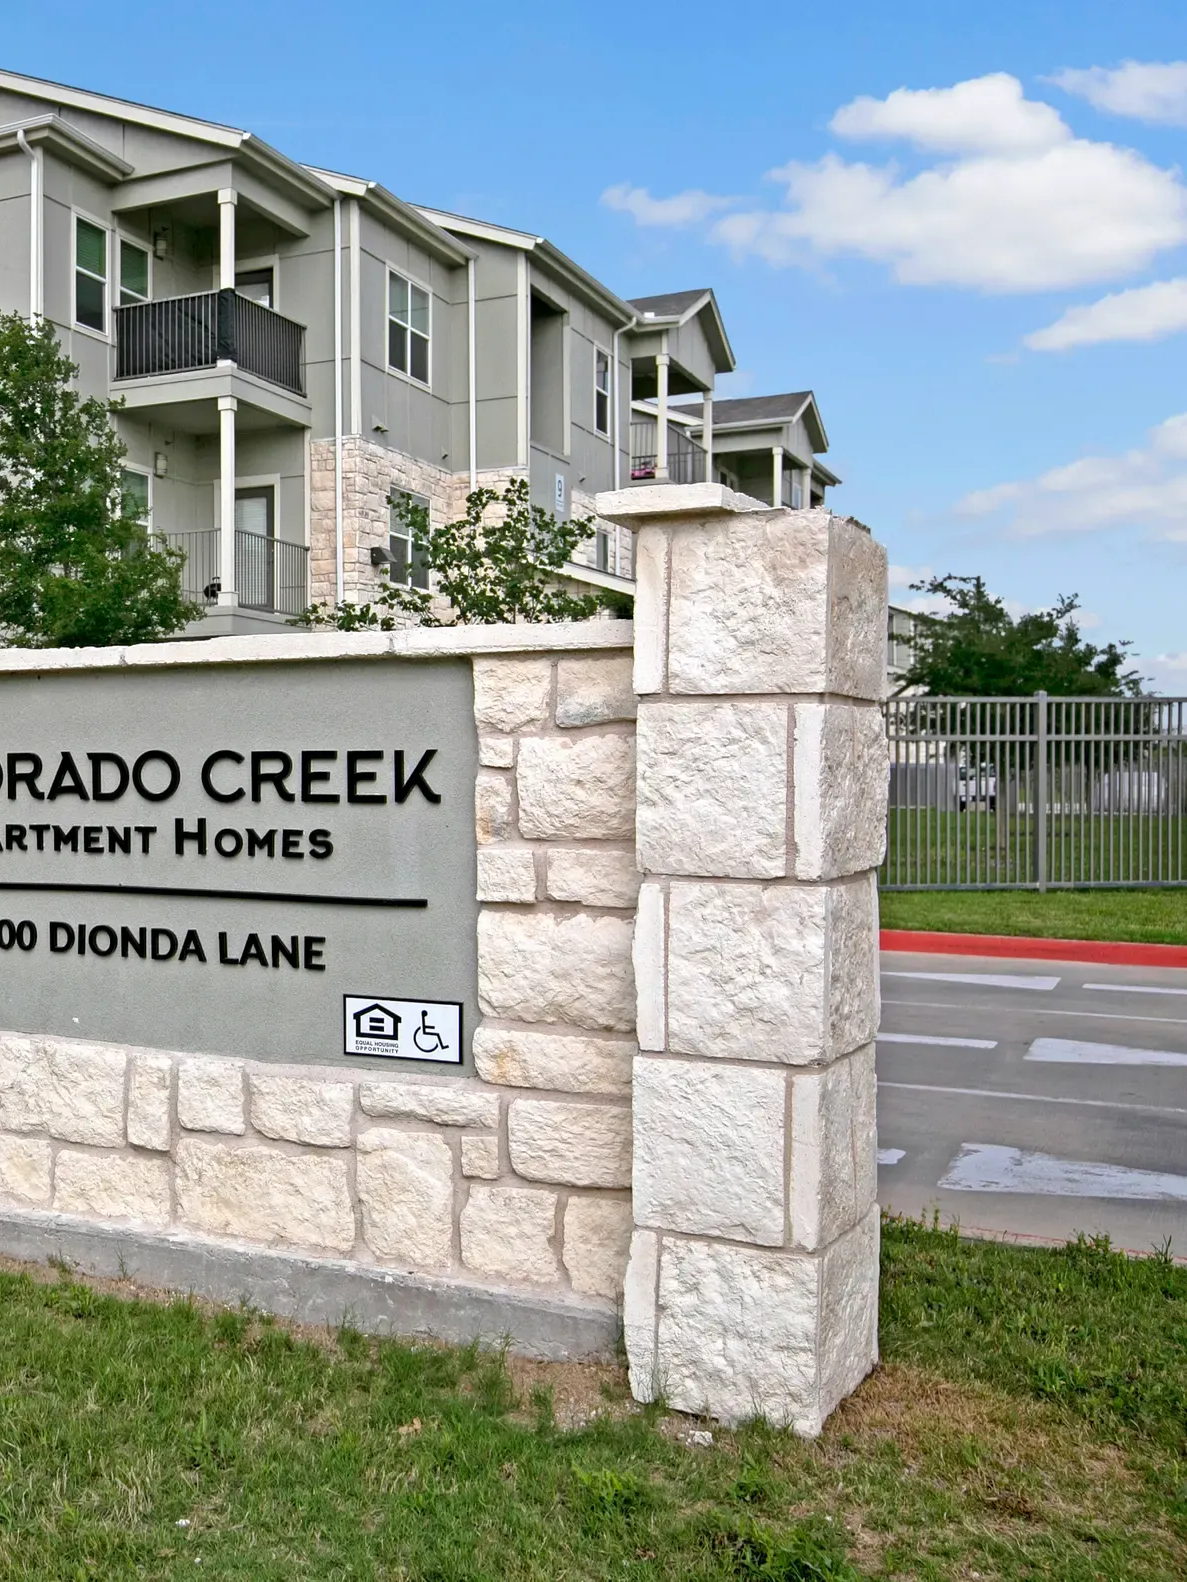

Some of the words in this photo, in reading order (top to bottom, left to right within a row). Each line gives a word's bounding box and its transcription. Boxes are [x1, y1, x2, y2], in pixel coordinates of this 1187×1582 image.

[201, 749, 442, 805] CREEK
[175, 817, 334, 860] HOMES
[50, 921, 207, 963] DIONDA
[219, 932, 326, 971] LANE
